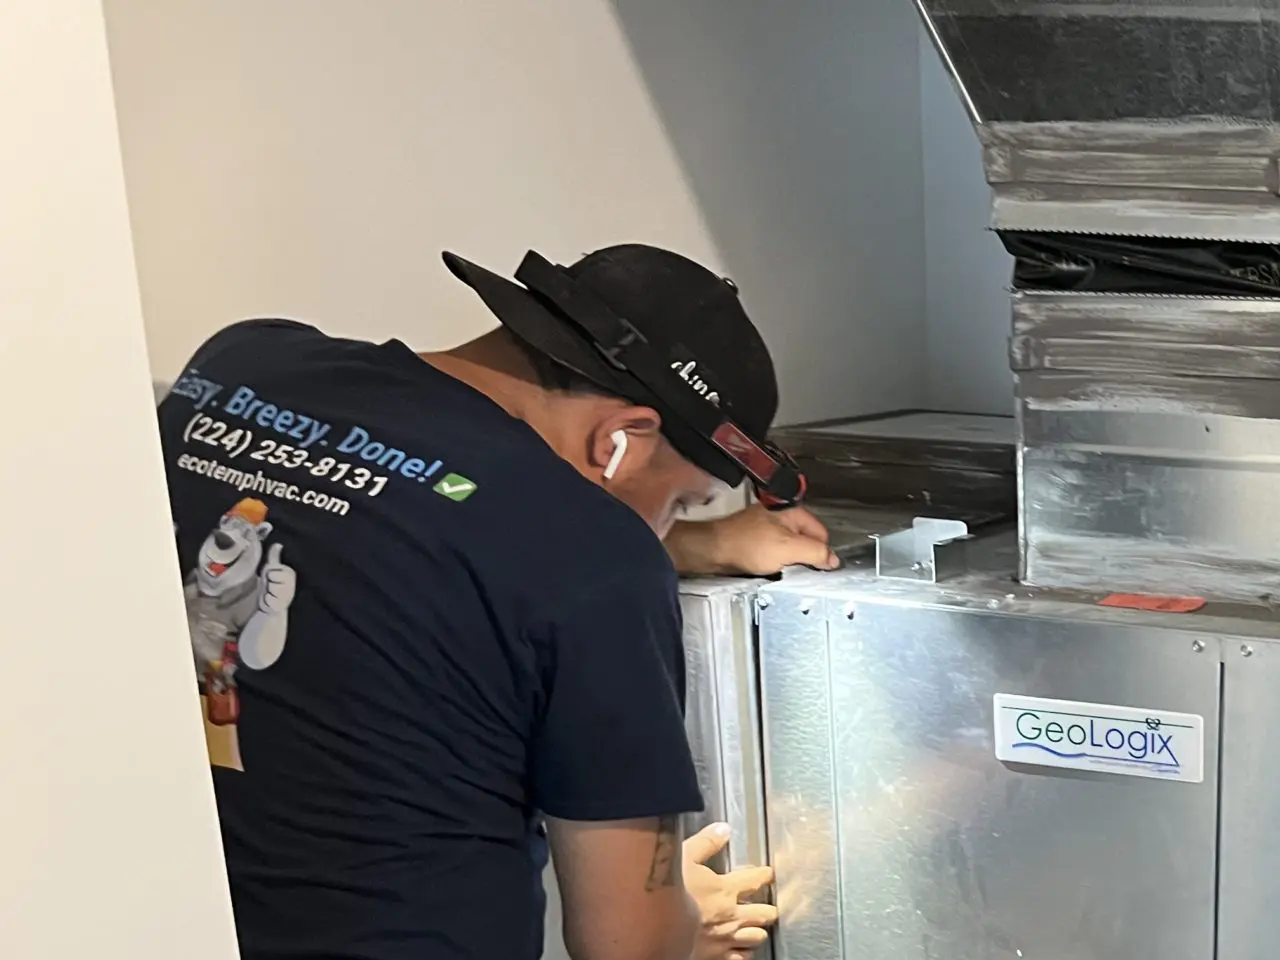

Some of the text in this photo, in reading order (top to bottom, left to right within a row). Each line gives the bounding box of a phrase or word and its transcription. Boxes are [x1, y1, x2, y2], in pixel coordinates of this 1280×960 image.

[183, 413, 389, 498] (224) 253-8131
[225, 386, 330, 448] Breezy.
[337, 425, 444, 484] Done!
[177, 452, 350, 517] ecotemphvac.com
[1016, 712, 1180, 766] GeoLogix
